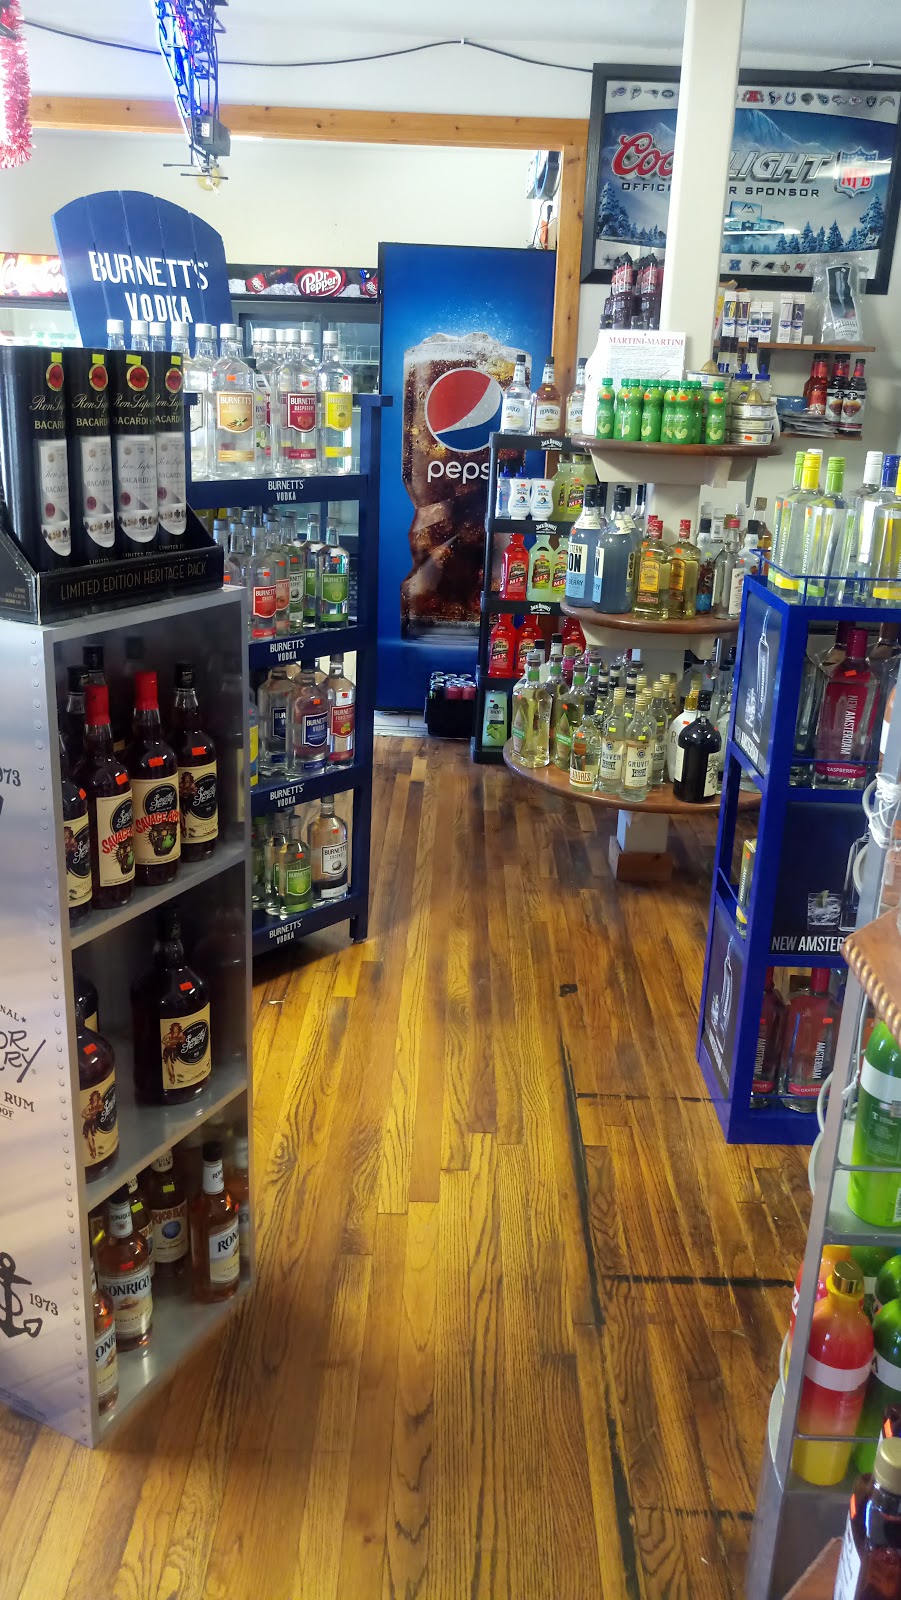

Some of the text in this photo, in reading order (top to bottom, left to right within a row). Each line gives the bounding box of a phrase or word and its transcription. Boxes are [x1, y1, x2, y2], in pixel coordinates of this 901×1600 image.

[611, 132, 833, 184] Coo LIGHT
[622, 183, 670, 192] OFFICI
[745, 187, 820, 198] SPONSOR
[88, 251, 209, 290] BURNETT'S
[314, 270, 330, 281] Dr
[305, 274, 338, 294] Pepper
[124, 292, 194, 323] VODKA
[608, 336, 684, 346] MARTINI-MARTINI
[34, 420, 64, 430] BACAR
[268, 479, 305, 491] BURNETT'S
[276, 492, 297, 502] VODKA
[568, 498, 583, 507] MIX
[568, 553, 582, 573] ON
[60, 561, 206, 601] LIMITED EDITION HERITAGE PACK
[509, 576, 524, 585] MIX
[533, 574, 548, 582] MIX
[269, 638, 306, 653] BURNETT'S
[277, 650, 297, 662] VODKA
[491, 653, 507, 661] MIX
[840, 695, 858, 755] NEW AMSTERDAM
[0, 767, 21, 787] 73
[826, 766, 857, 774] RASPBERRY
[269, 783, 305, 801] BURNETT'S
[277, 795, 296, 808] VODKA
[135, 811, 168, 834] SAVAGE
[269, 918, 303, 939] BURNETT'S
[276, 930, 295, 945] VODKA
[771, 936, 844, 952] NEW AMSTER
[812, 1041, 826, 1079] AMSTERDAM
[4, 1091, 35, 1113] RUM
[29, 1293, 59, 1316] 1973
